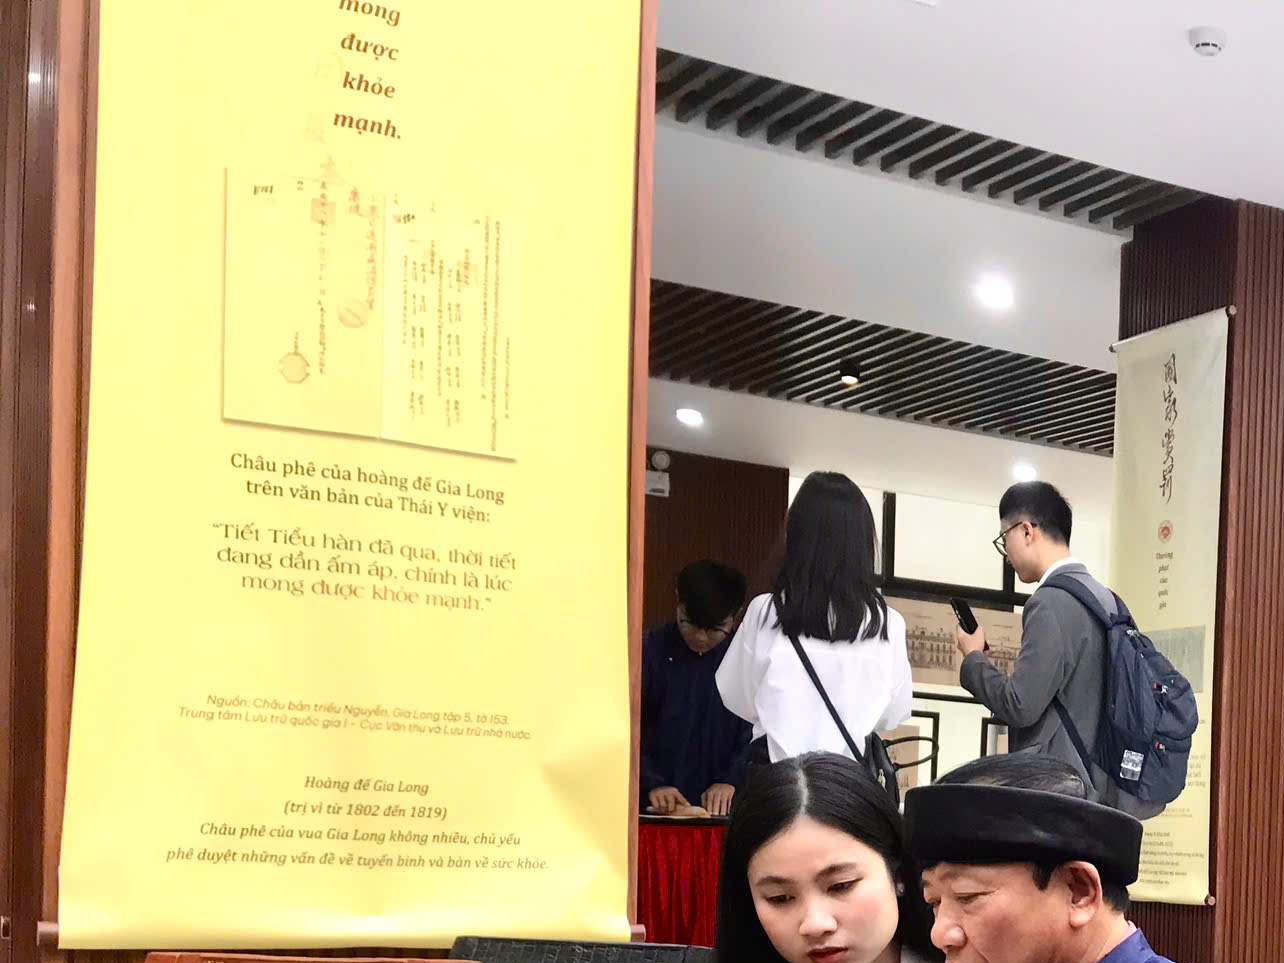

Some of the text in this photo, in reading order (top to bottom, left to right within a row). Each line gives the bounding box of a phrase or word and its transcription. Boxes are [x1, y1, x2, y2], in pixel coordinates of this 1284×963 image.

[339, 0, 400, 27] mong
[341, 33, 399, 60] được
[343, 71, 395, 98] khỏe
[334, 112, 401, 140] mạnh.
[230, 452, 505, 506] Châu phê của hoàng đế Gia Long
[246, 480, 490, 523] trên văn bản của Thái Y viện:
[267, 527, 316, 548] Tiểu
[322, 532, 362, 553] hàn
[368, 538, 394, 556] đã
[448, 548, 483, 566] thời
[489, 551, 516, 570] tiết
[279, 550, 320, 571] dần
[327, 555, 361, 575] ấm
[404, 565, 457, 586] chính
[463, 570, 479, 589] là
[485, 572, 513, 592] lúc
[241, 574, 304, 597] mong
[311, 578, 365, 600] được
[372, 583, 420, 604] khỏe
[179, 706, 215, 721] Trung
[304, 776, 430, 796] Hoàng đế Gia Long
[284, 800, 448, 821] (trị vì từ 1802 đến 1819)
[200, 822, 521, 848] Châu phê của vua Gia Long không nhiều, chủ yếu
[166, 848, 194, 862] phê
[197, 848, 237, 864] duyệt
[241, 849, 287, 866] những
[291, 850, 315, 864] vấn
[319, 852, 335, 866] đề
[339, 853, 354, 866] về
[429, 856, 444, 868] và
[475, 856, 489, 869] về
[491, 858, 514, 869] sức
